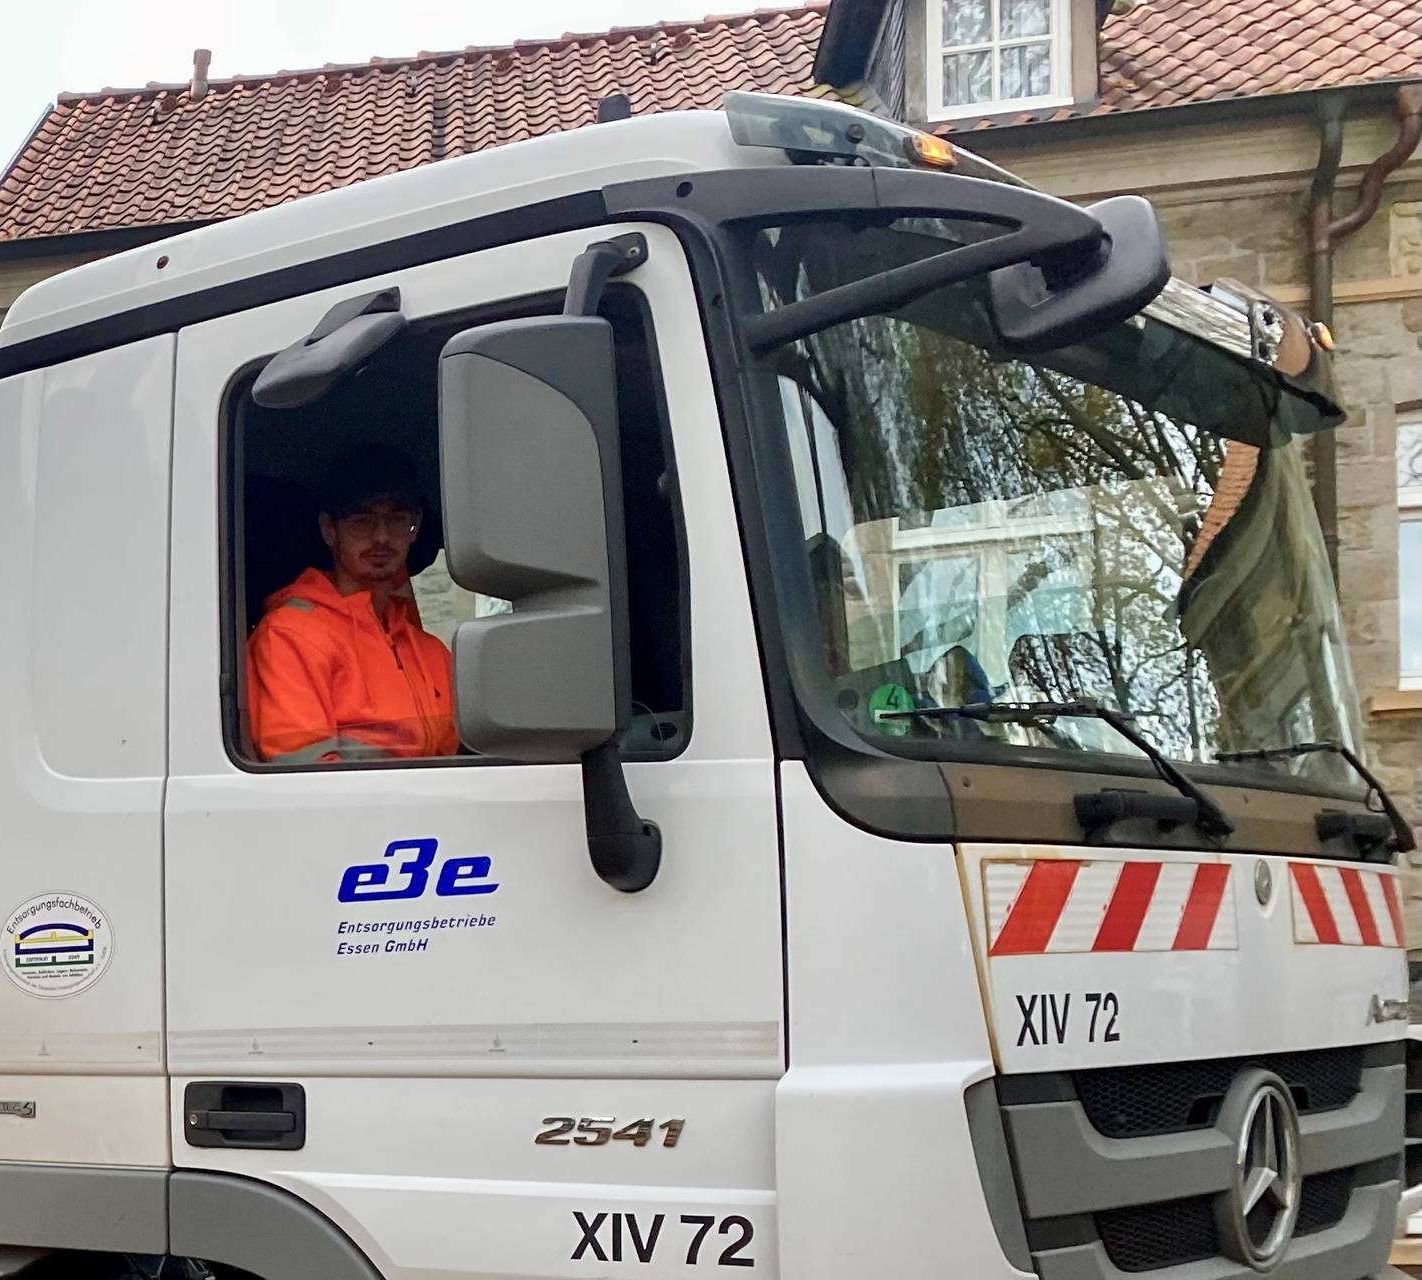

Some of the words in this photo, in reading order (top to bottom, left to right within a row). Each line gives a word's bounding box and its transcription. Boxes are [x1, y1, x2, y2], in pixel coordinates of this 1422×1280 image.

[886, 686, 898, 706] 4
[338, 837, 500, 903] e3e
[6, 897, 102, 935] Entsorgungsfachbetrieb
[337, 913, 497, 935] Entsorgungsbetriebe
[337, 943, 379, 955] Essen
[384, 938, 428, 953] GmbH
[1016, 993, 1071, 1047] XIV
[1085, 992, 1120, 1043] 72
[534, 1116, 685, 1147] 2541
[570, 1211, 666, 1263] XIV
[680, 1214, 755, 1267] 72
